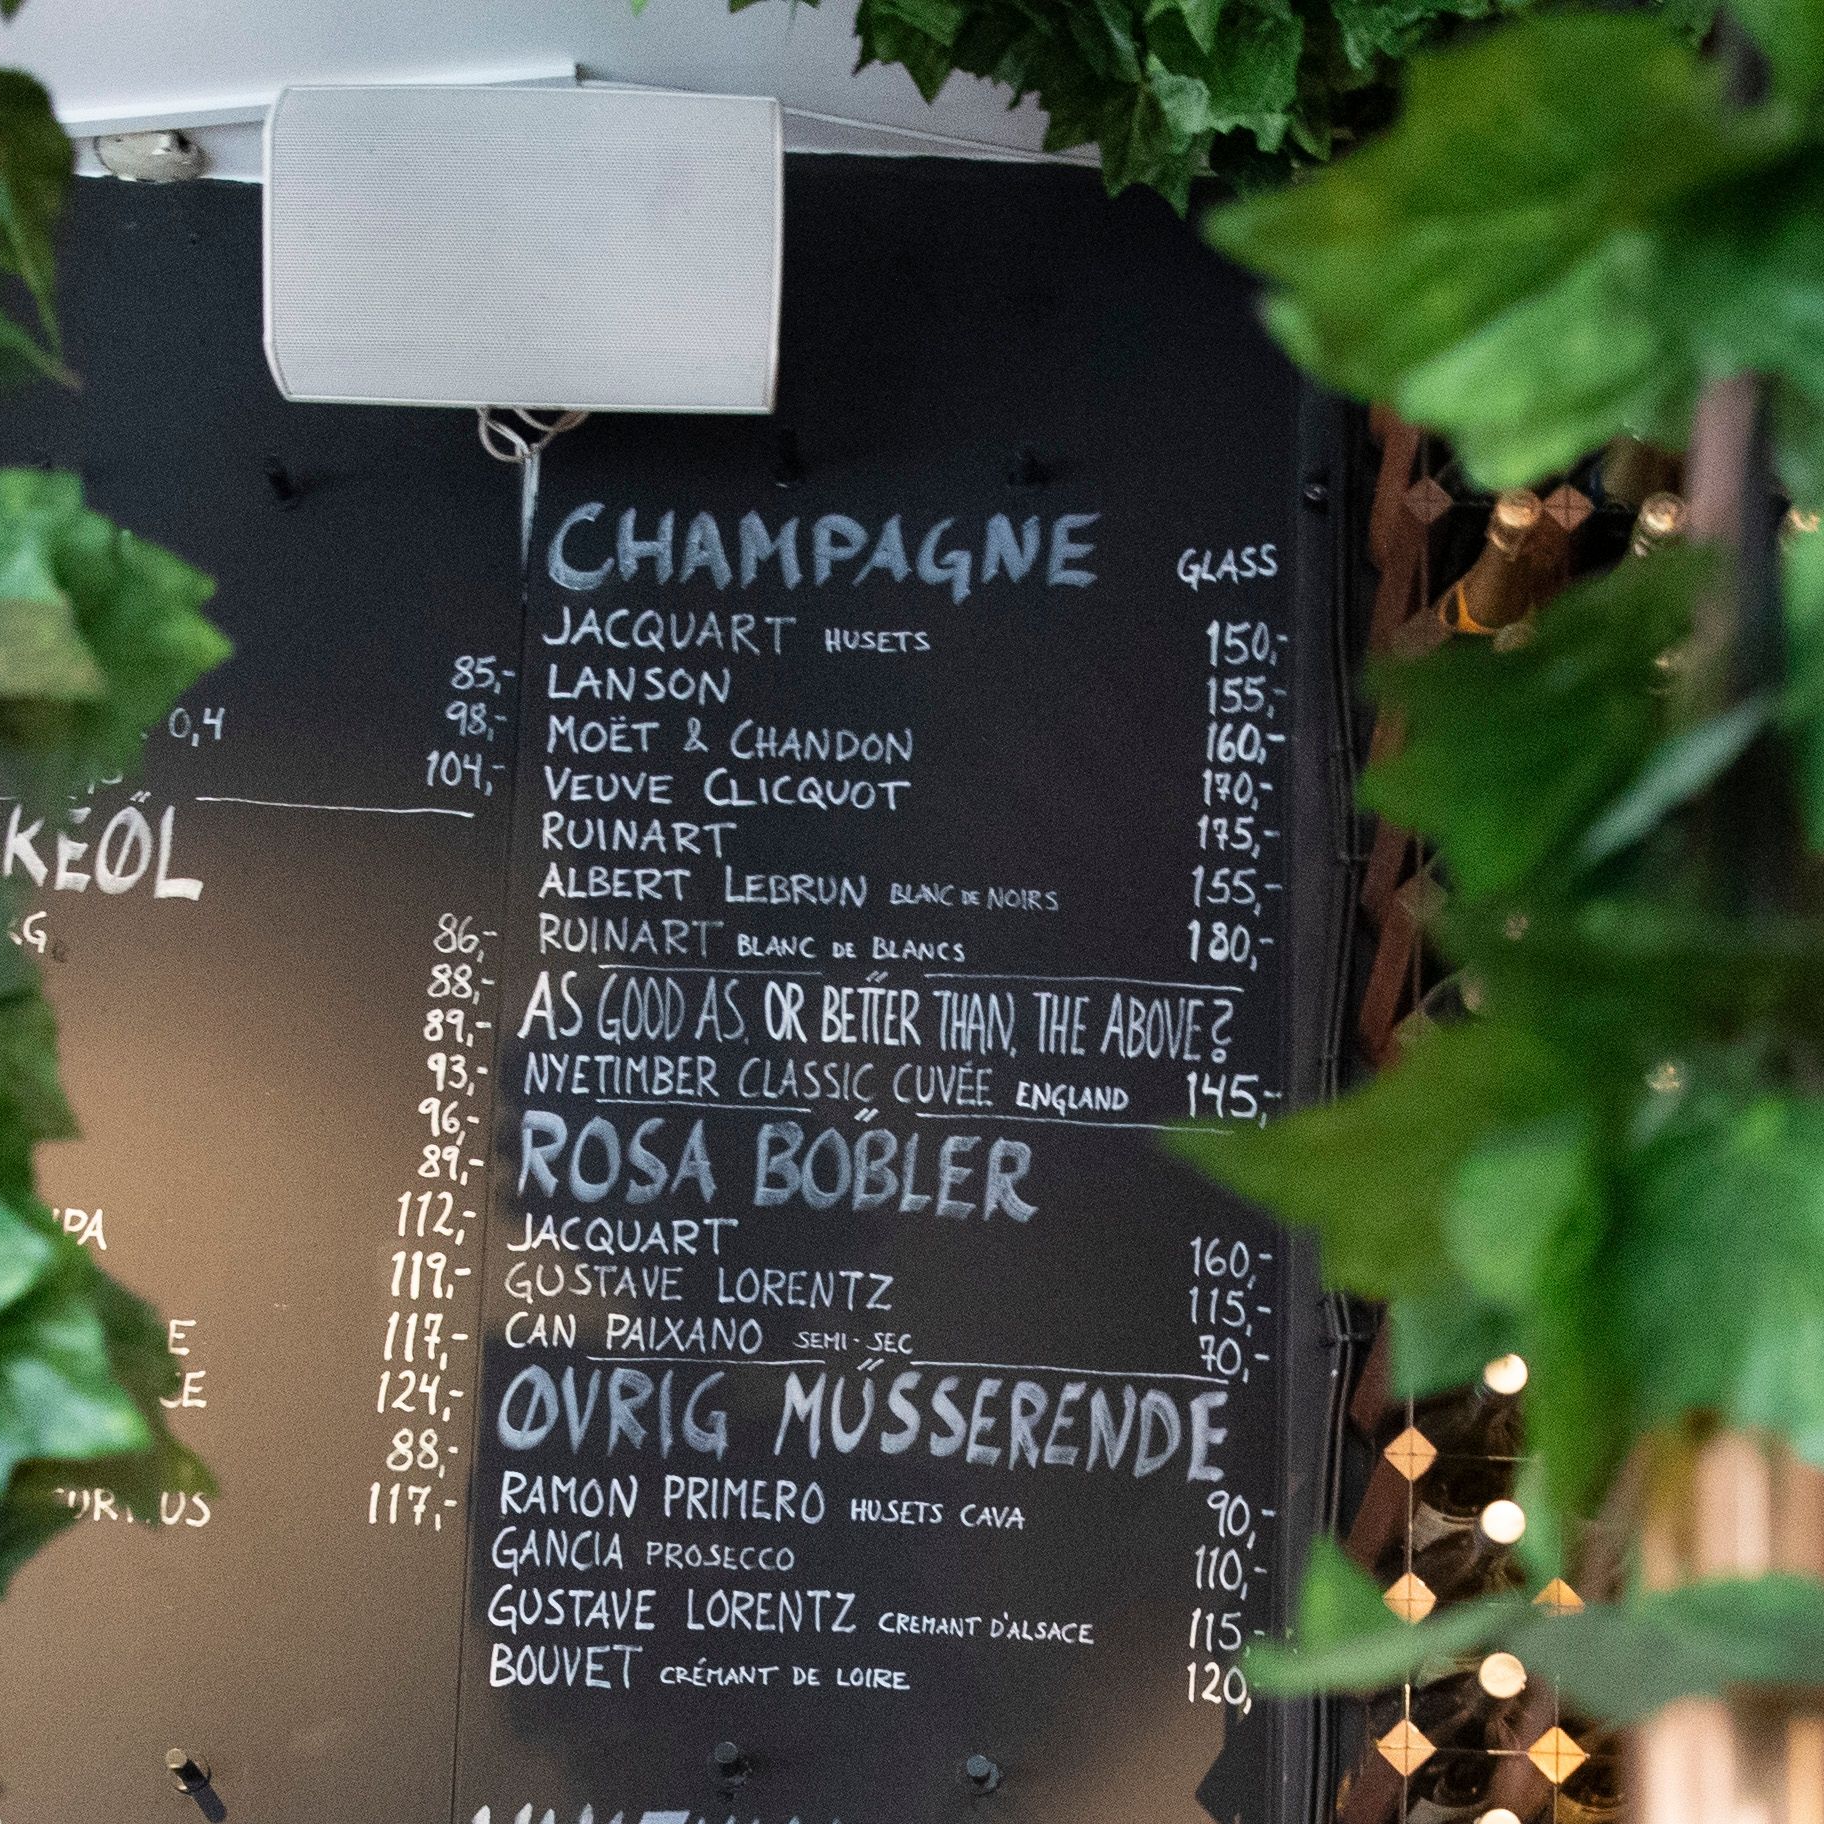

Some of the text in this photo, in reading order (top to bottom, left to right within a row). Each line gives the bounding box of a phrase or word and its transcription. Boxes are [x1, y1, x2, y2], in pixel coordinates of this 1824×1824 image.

[547, 501, 1278, 604] CHAMPAGNE GLASS
[541, 605, 1289, 667] JACQUART HUSETS 150,-
[450, 654, 515, 695] 85,-
[546, 662, 732, 706] LANSON
[169, 706, 226, 748] 0,4
[546, 713, 914, 765] MOËT & CHANDON
[425, 749, 504, 796] 104,-
[543, 764, 912, 811] VEUVE CLICQUOT
[541, 809, 738, 859] RUINART
[537, 861, 692, 901] ALBERT
[724, 864, 868, 908] LEBRUN
[888, 881, 955, 907] BLANC
[986, 886, 1060, 912] NOIRS
[538, 911, 724, 957] RUINART
[736, 932, 815, 960] BLANC
[871, 935, 966, 963] BLANCS
[517, 970, 583, 1040] AS
[597, 972, 686, 1044] GOOD
[763, 980, 808, 1043] OR
[820, 984, 921, 1047] BETTER
[1032, 990, 1090, 1055] THE
[1100, 992, 1235, 1065] ABOVE?
[523, 1051, 1130, 1117] NYETIMBER CLASSIC CUVÉE ENGLAND
[518, 1109, 717, 1202] ROSA
[506, 1213, 1272, 1290] JACQUART 160,-
[503, 1260, 895, 1312] GUSTAVE LORENTZ
[504, 1310, 577, 1349] CAN
[605, 1311, 763, 1356] PAIXANO
[376, 1369, 465, 1423] 124,-
[498, 1364, 729, 1459] ØVRIG
[499, 1469, 1026, 1530] RAMON PRIMERO HUSETS CAVA
[491, 1525, 796, 1576] GANCIA PROSECCO
[487, 1583, 1095, 1646] GUSTAVE LORENTZ CREMANT D'ALSACE
[488, 1642, 644, 1690] BOUVET
[658, 1656, 780, 1688] CRÉMANT
[835, 1666, 911, 1691] LOIRE
